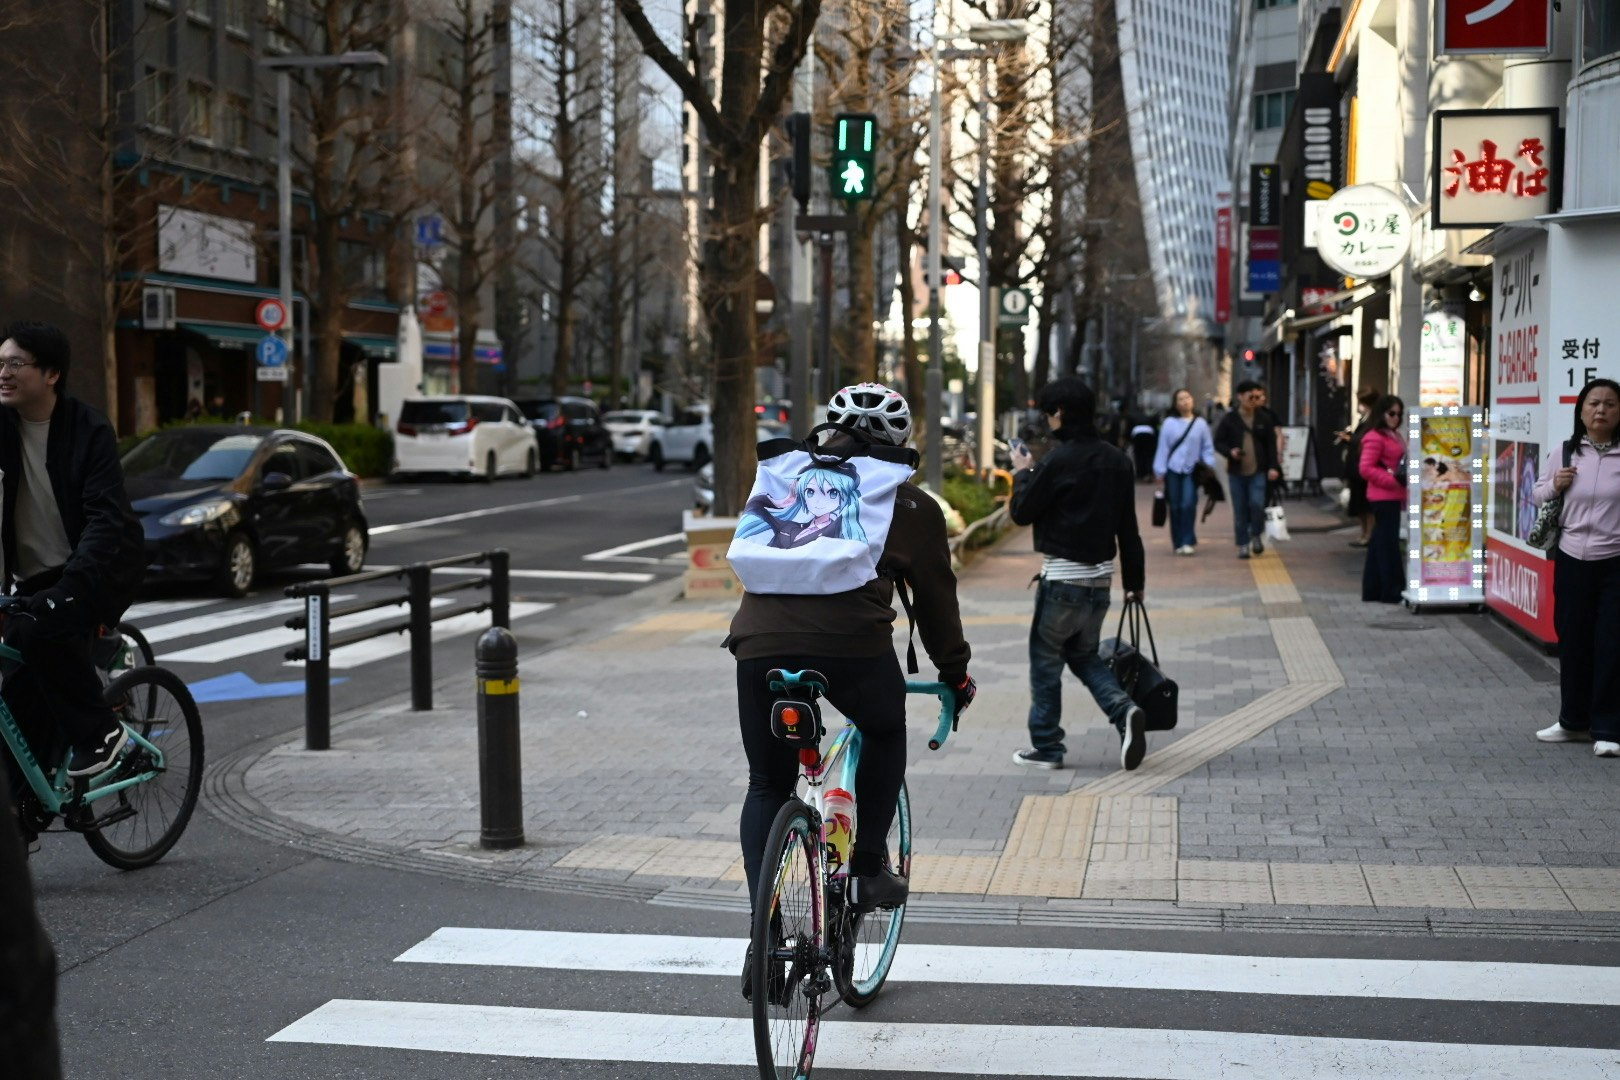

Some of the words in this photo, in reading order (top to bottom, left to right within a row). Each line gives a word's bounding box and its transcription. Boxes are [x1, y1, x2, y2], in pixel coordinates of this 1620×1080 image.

[1443, 138, 1549, 198] 油そば
[1340, 241, 1394, 256] カレー
[1562, 338, 1600, 360] 受付
[1492, 552, 1538, 619] KARAOKE
